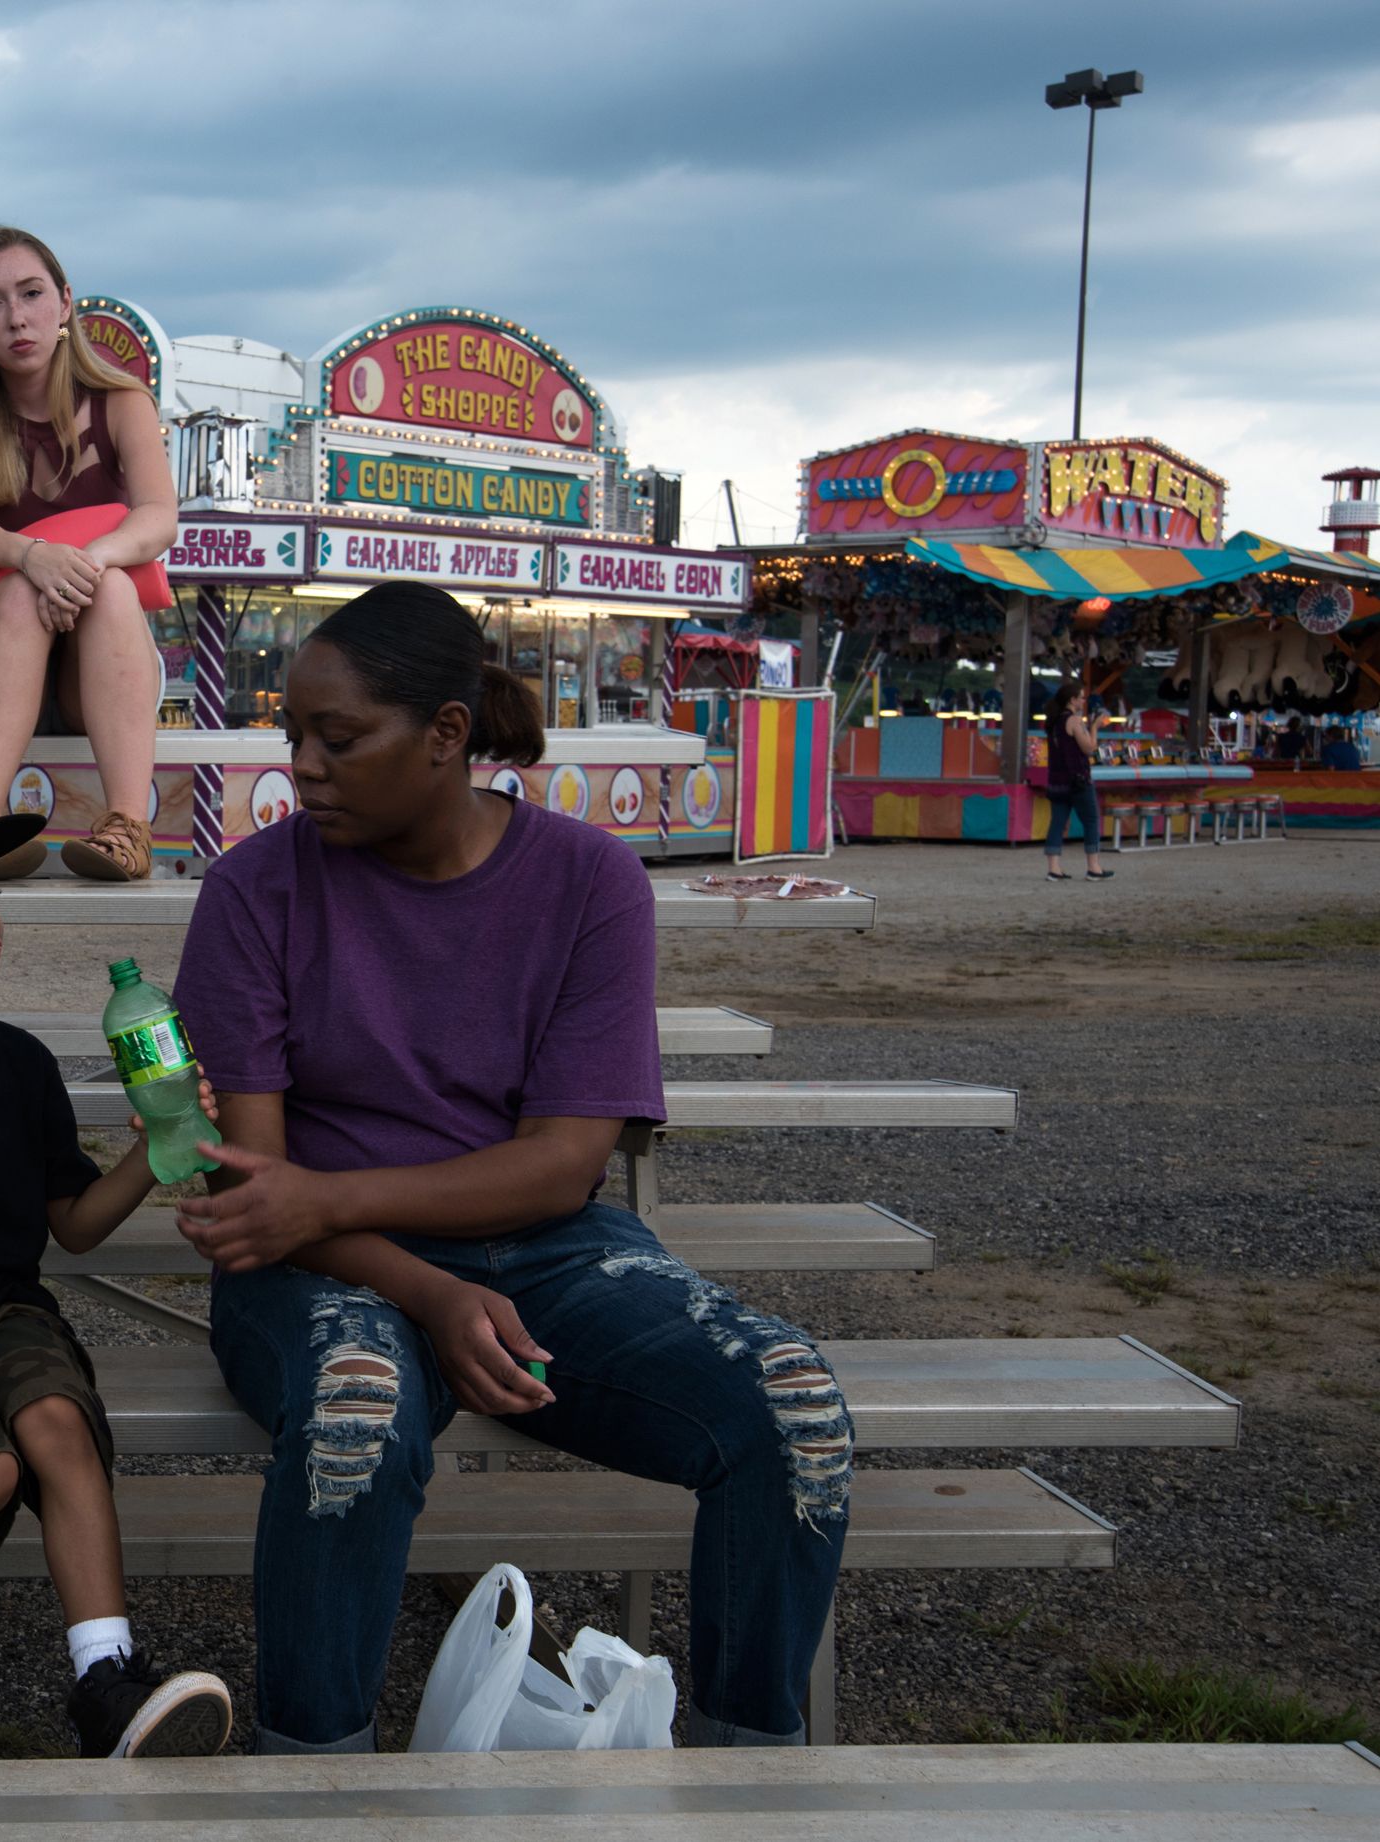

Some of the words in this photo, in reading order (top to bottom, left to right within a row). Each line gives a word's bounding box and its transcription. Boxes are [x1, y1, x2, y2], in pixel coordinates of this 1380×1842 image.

[80, 320, 138, 363] ANDY
[395, 334, 450, 377] THE
[459, 335, 546, 399] CANDY
[421, 379, 520, 427] SHOPPÉ
[358, 459, 474, 504] COTTON
[482, 473, 571, 517] CANDY
[1047, 447, 1218, 544] WATER
[170, 546, 266, 568] DRINKS
[183, 529, 252, 547] COLD
[345, 536, 441, 573] CARAMEL
[450, 544, 519, 578] APPLES
[579, 554, 666, 593] CARAMEL
[674, 563, 723, 597] CORN
